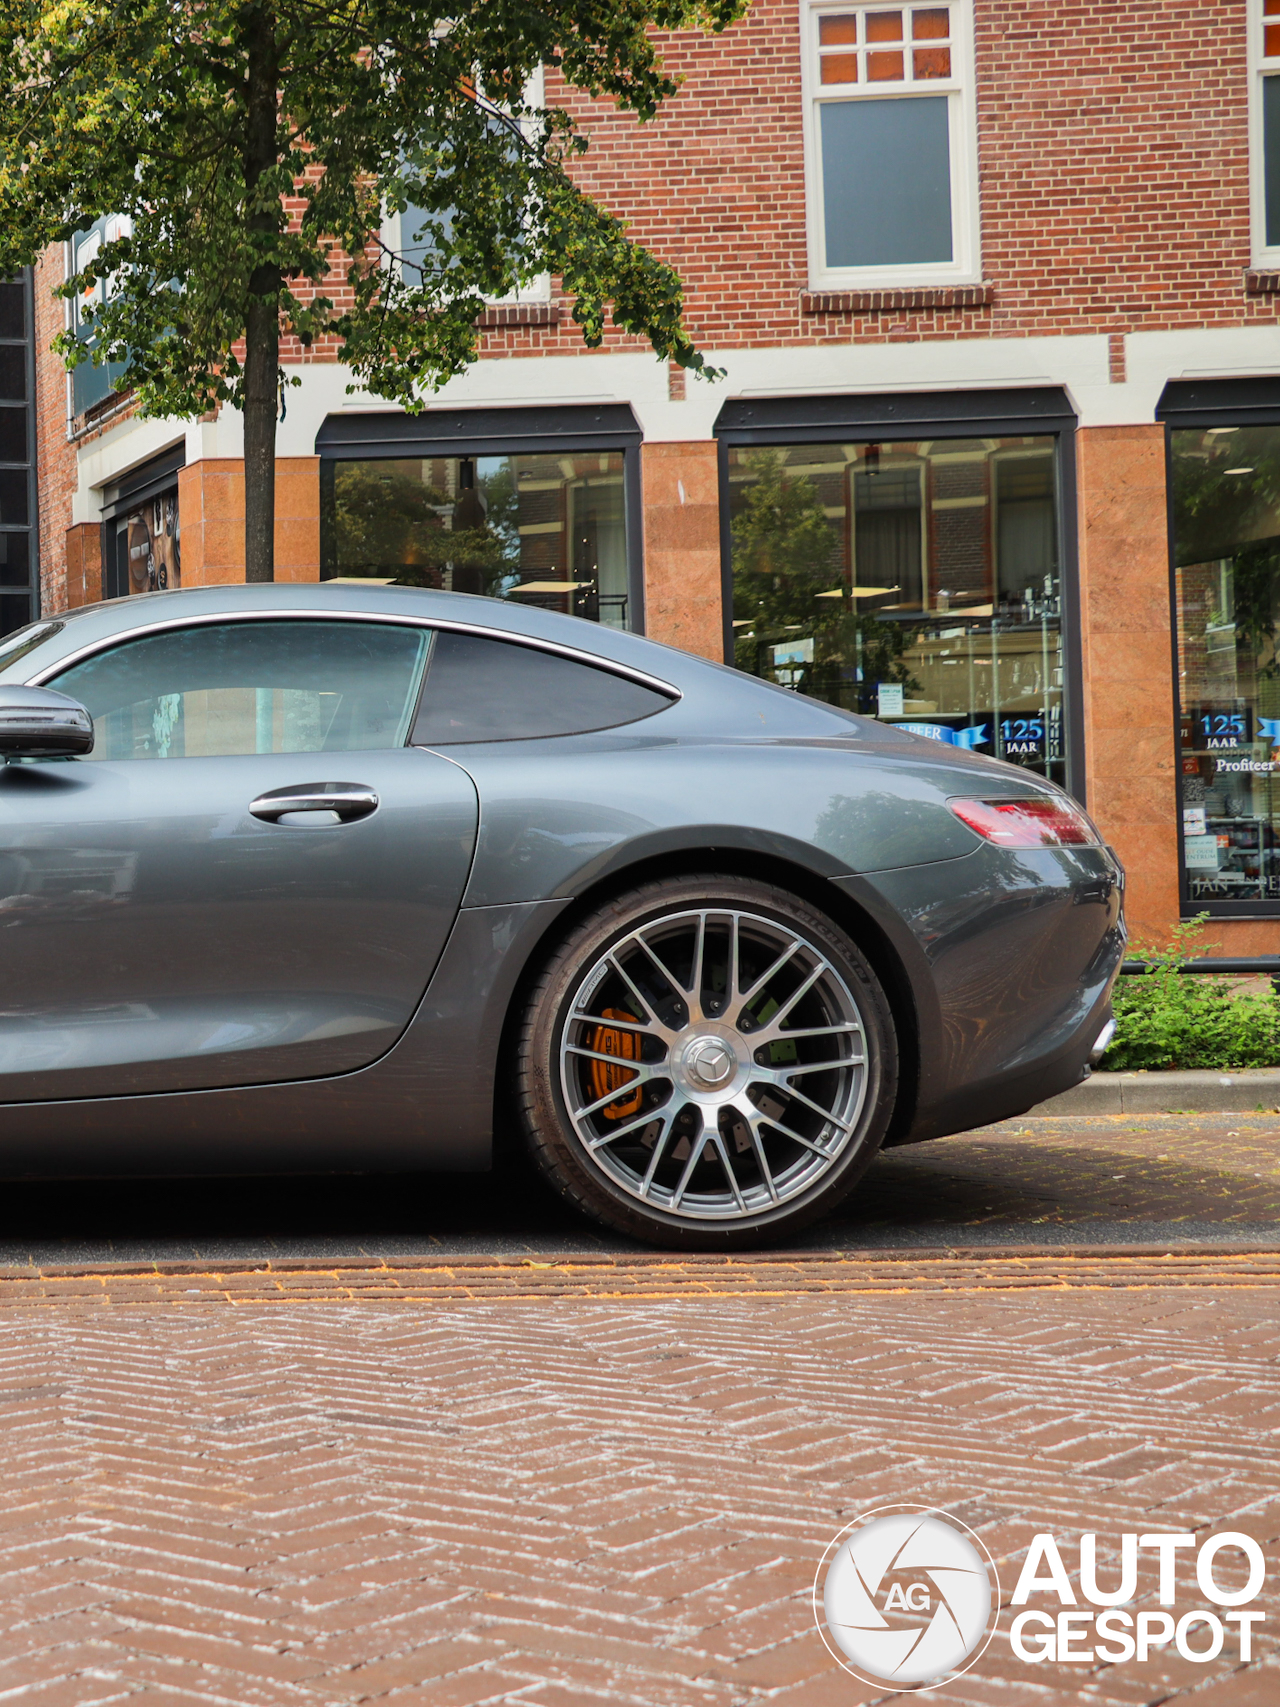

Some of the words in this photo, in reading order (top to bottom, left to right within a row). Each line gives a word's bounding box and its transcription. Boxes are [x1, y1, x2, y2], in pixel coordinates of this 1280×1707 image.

[1000, 719, 1043, 741] 125
[1201, 714, 1245, 736] 125
[1006, 742, 1037, 754] JAAR
[1207, 738, 1238, 749] JAAR
[1216, 758, 1275, 772] Profiteer
